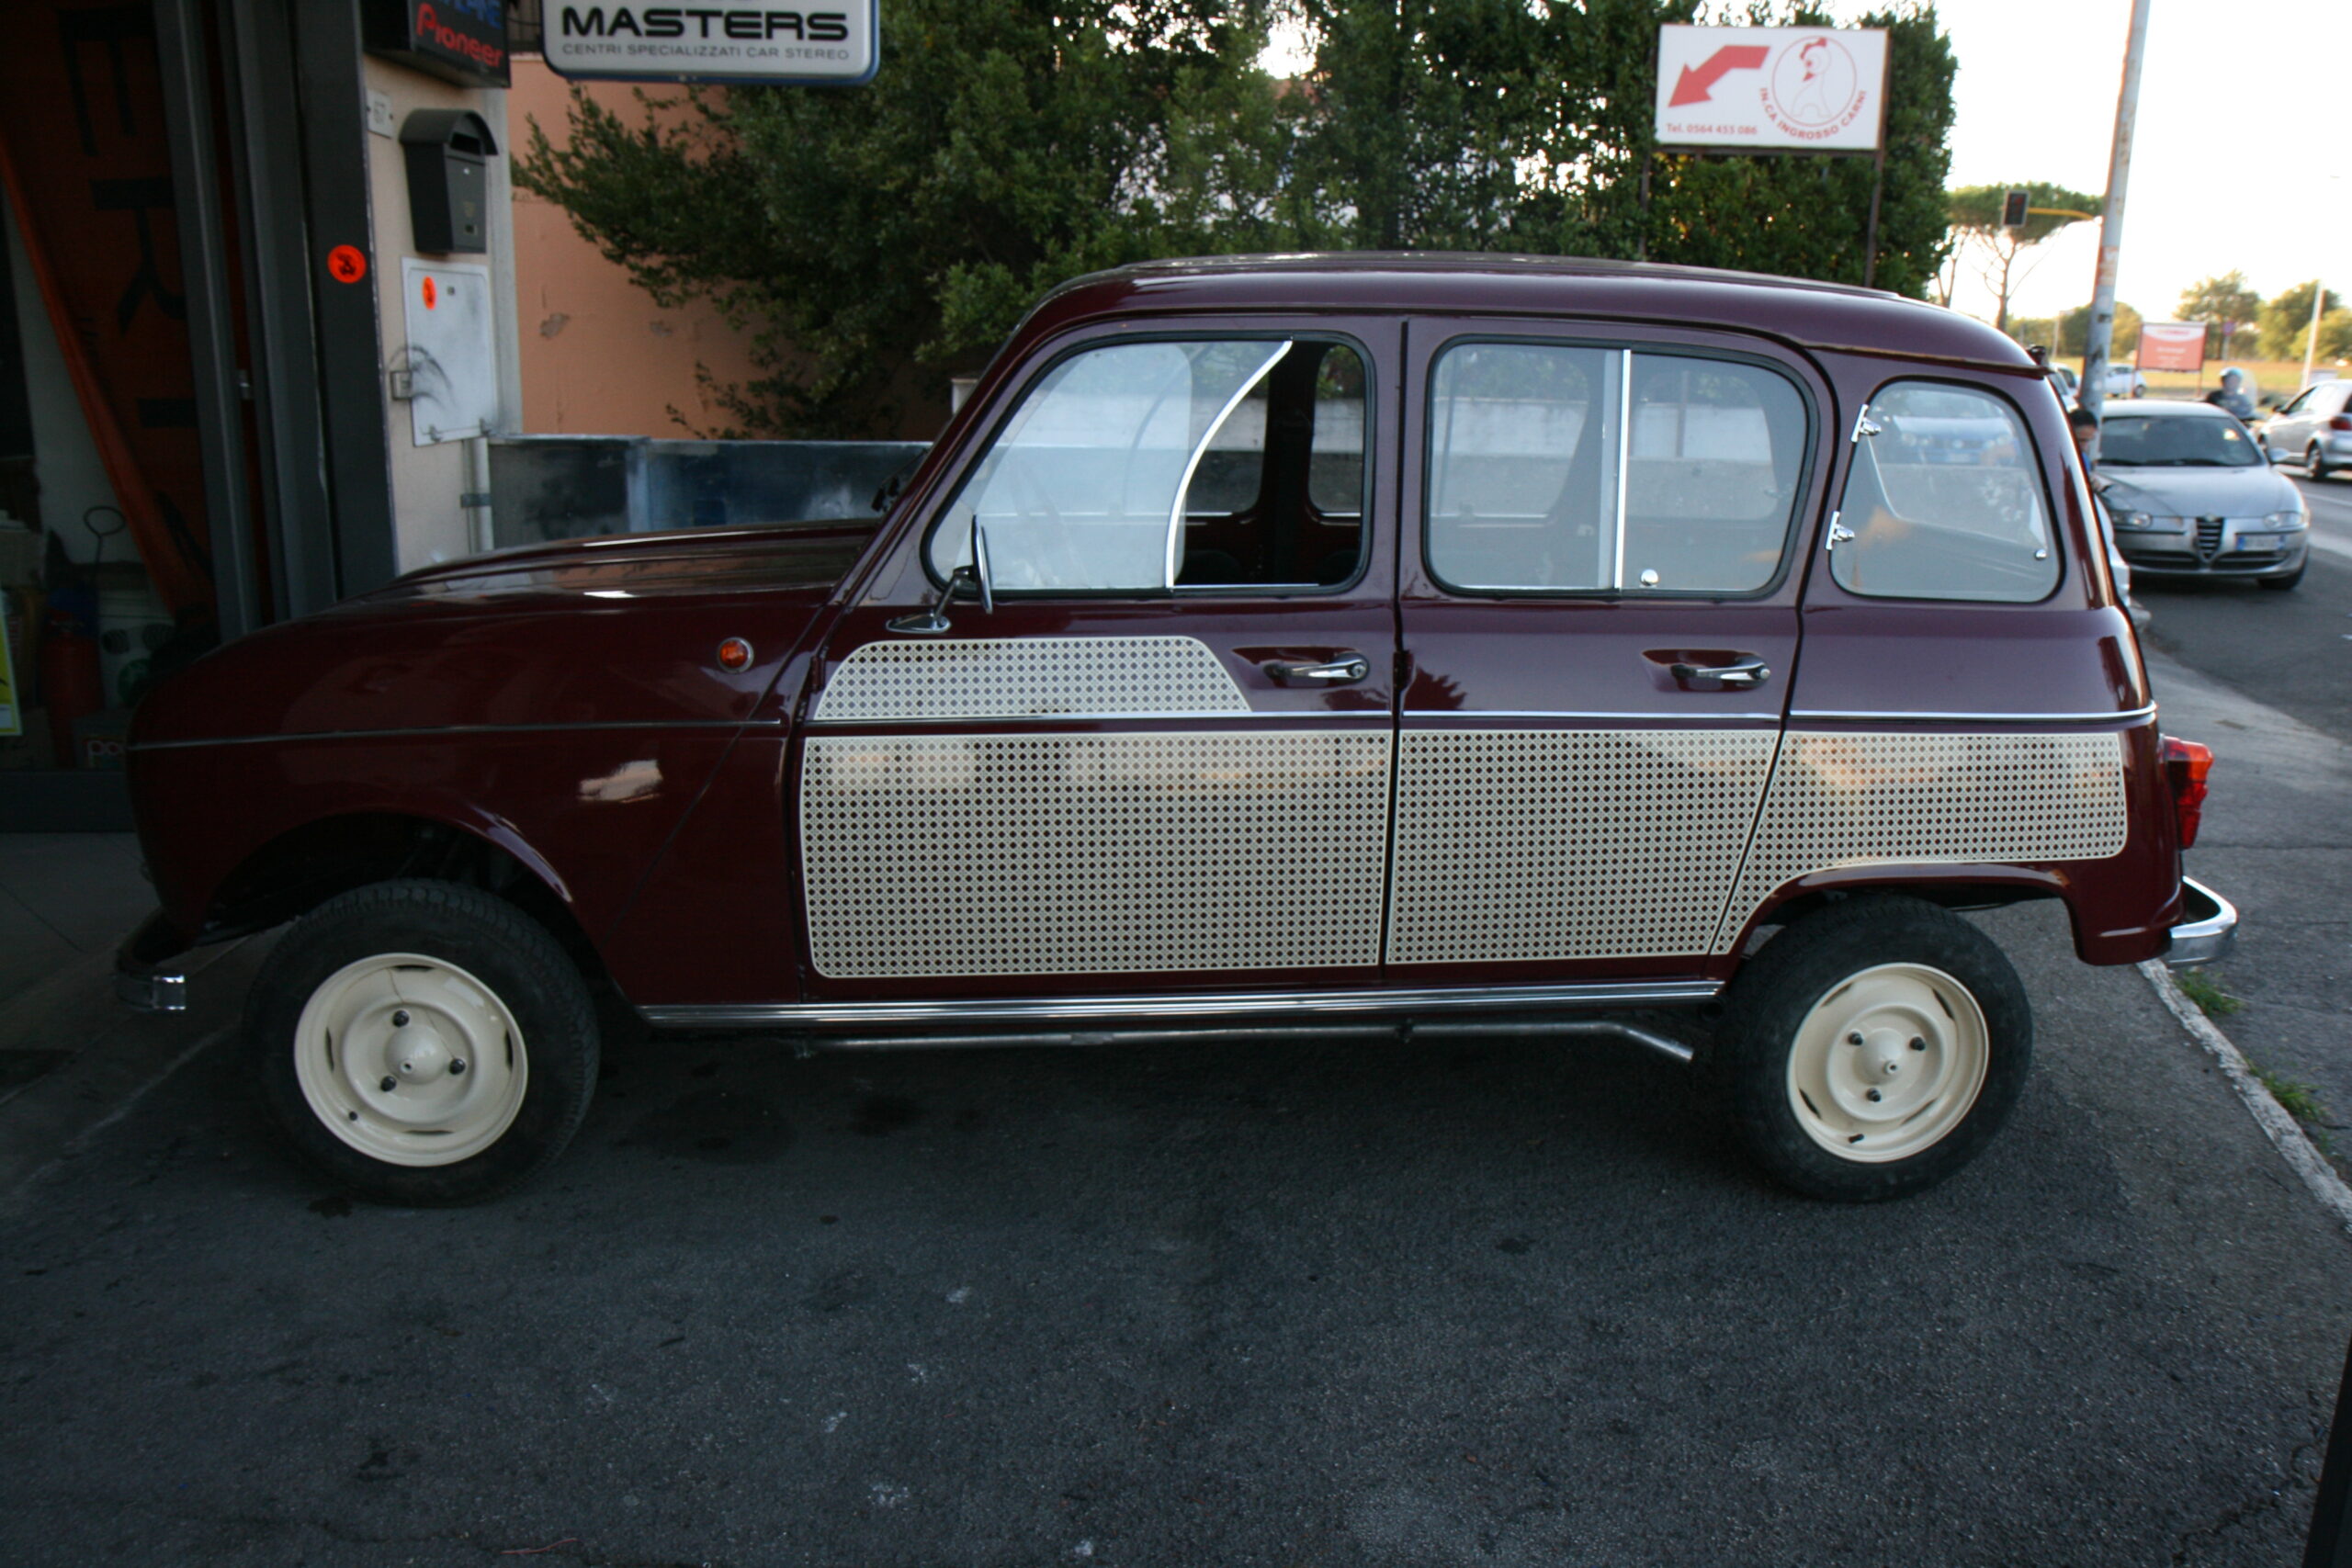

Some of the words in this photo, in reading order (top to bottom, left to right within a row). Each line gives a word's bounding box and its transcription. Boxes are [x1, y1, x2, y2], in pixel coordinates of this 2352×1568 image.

[416, 2, 504, 67] Pioneer
[561, 6, 849, 41] MASTERS
[562, 43, 622, 56] CENTRI
[627, 45, 741, 58] SPECIALIZZATI
[746, 49, 779, 59] CAR
[785, 49, 850, 61] STEREO
[1666, 122, 1685, 133] Tel.
[1777, 119, 1839, 140] INGROSSO
[1839, 89, 1866, 127] CARNI
